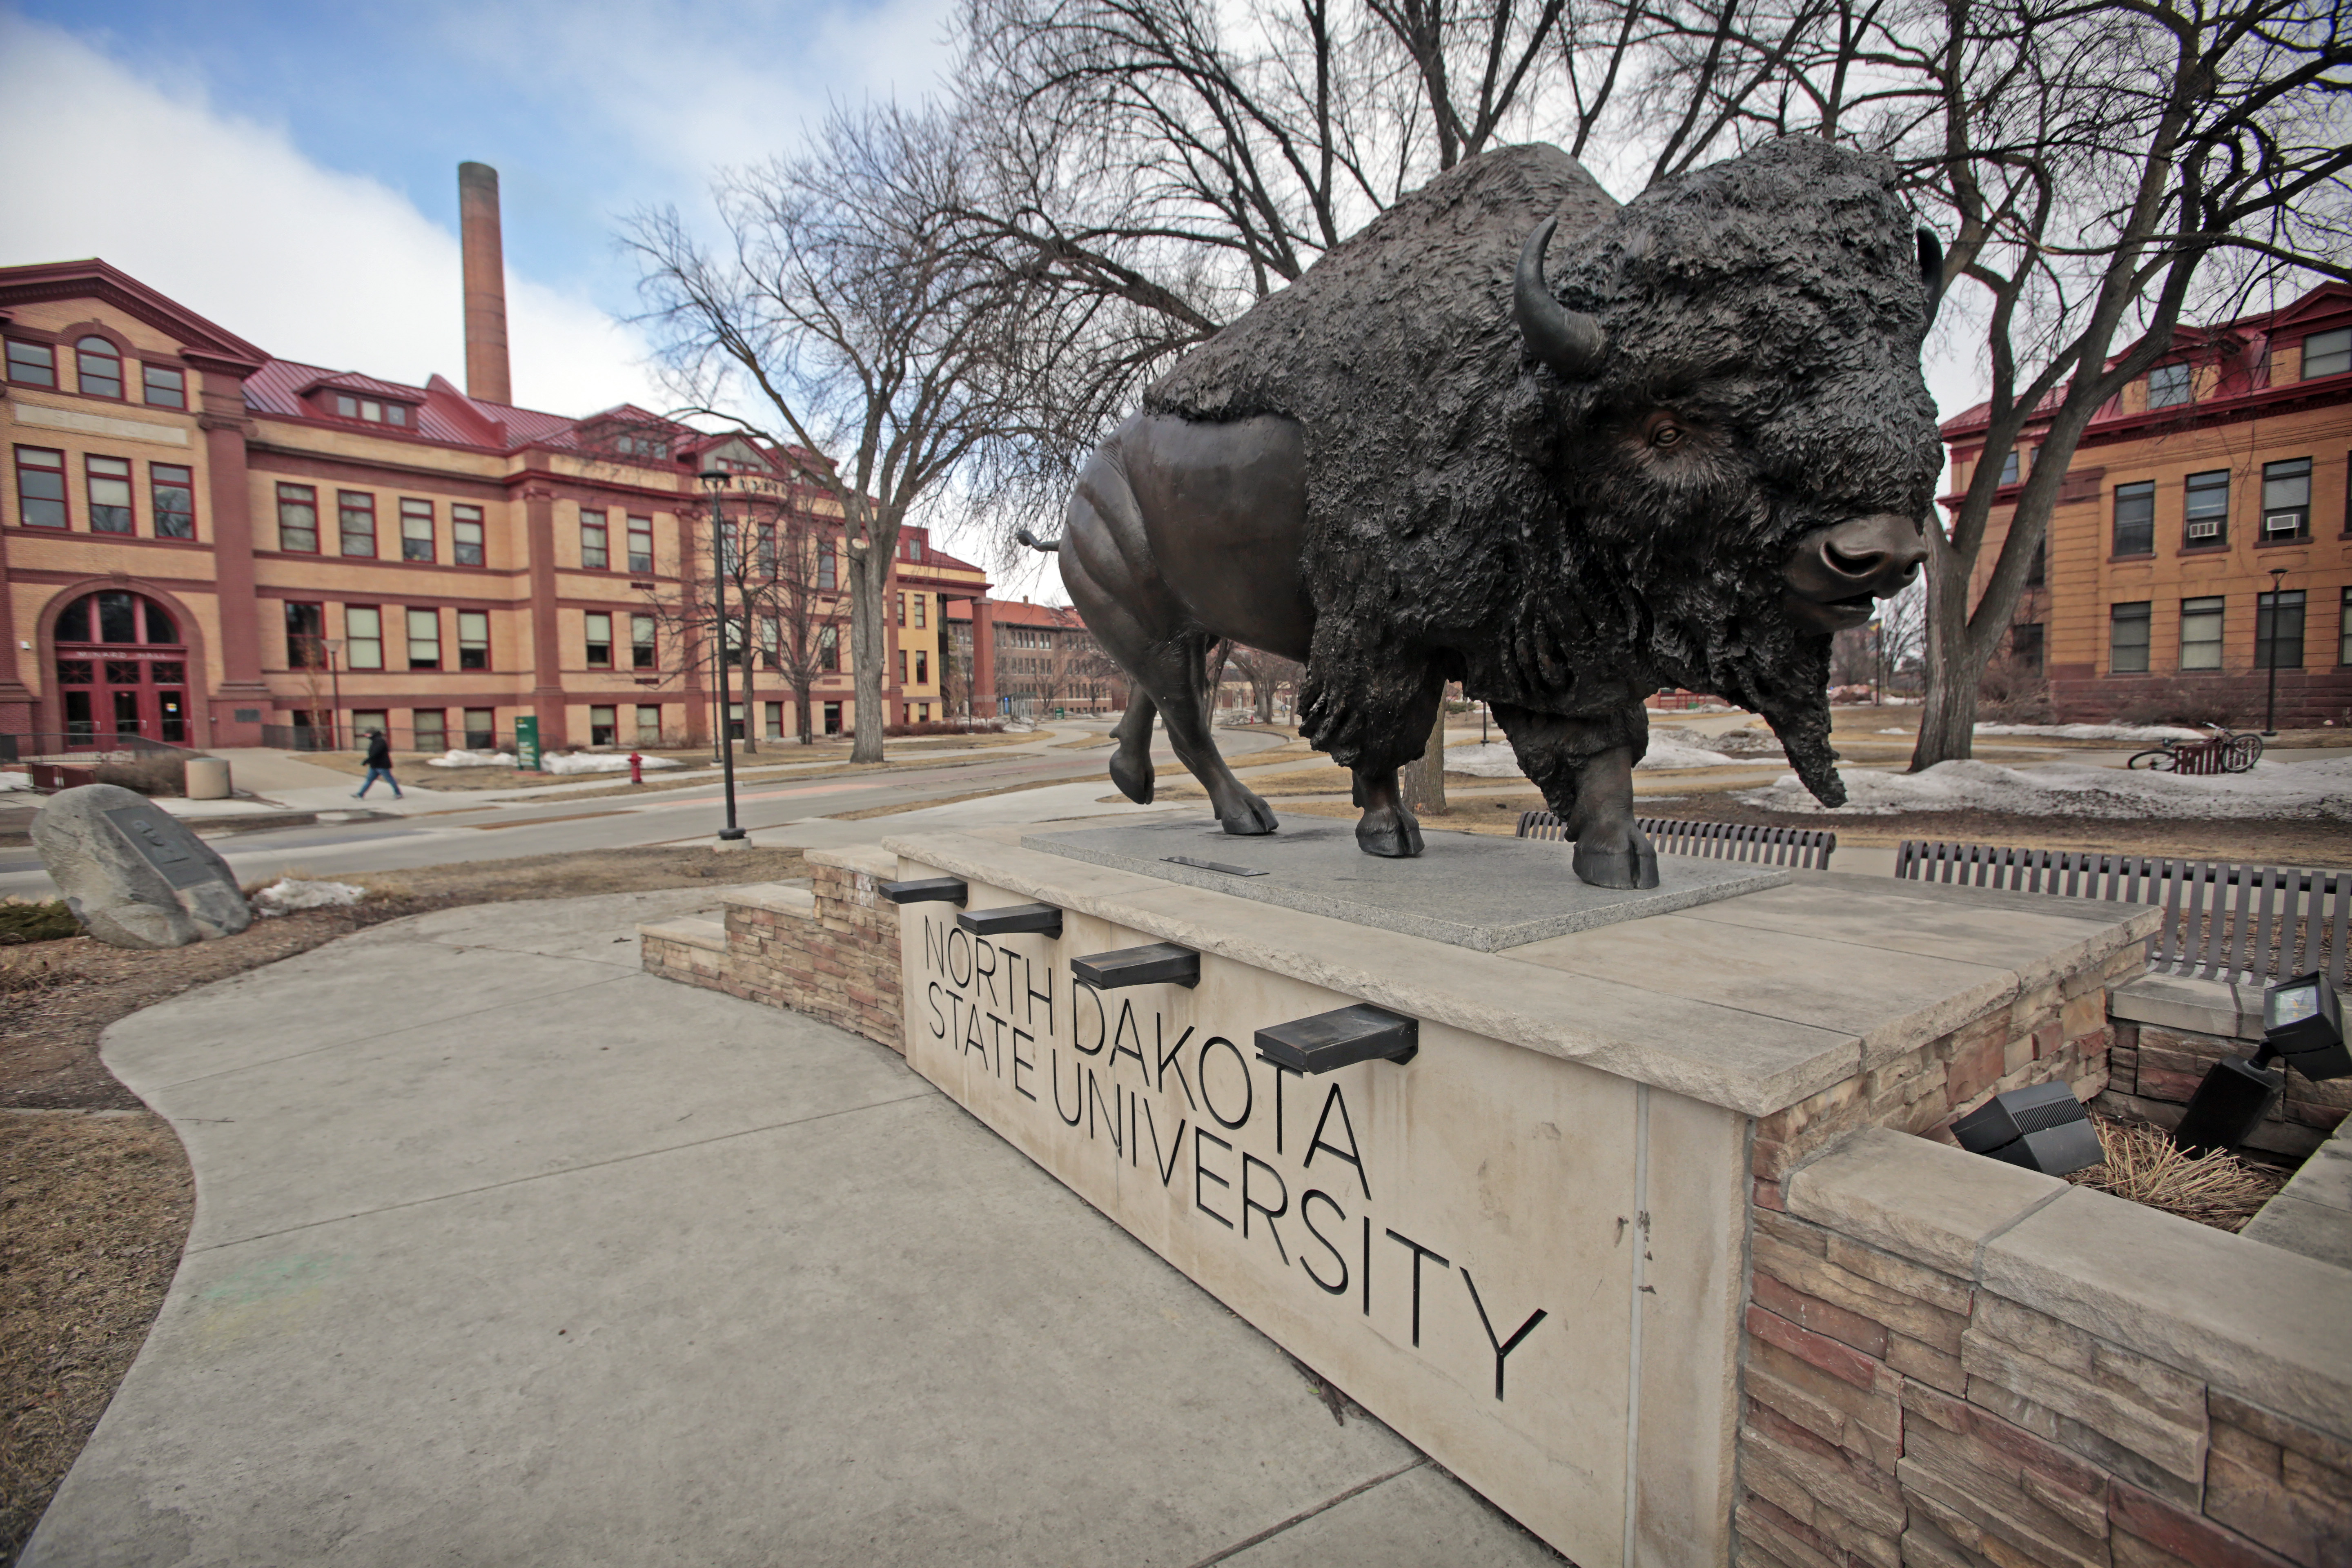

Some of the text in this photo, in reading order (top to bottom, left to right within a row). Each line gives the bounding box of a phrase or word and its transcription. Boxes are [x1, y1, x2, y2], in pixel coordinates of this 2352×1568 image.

[53, 412, 154, 437] SCIENCE
[925, 915, 1372, 1201] NORTH DAKOTA
[929, 981, 1548, 1401] STATE UNIVERSITY
